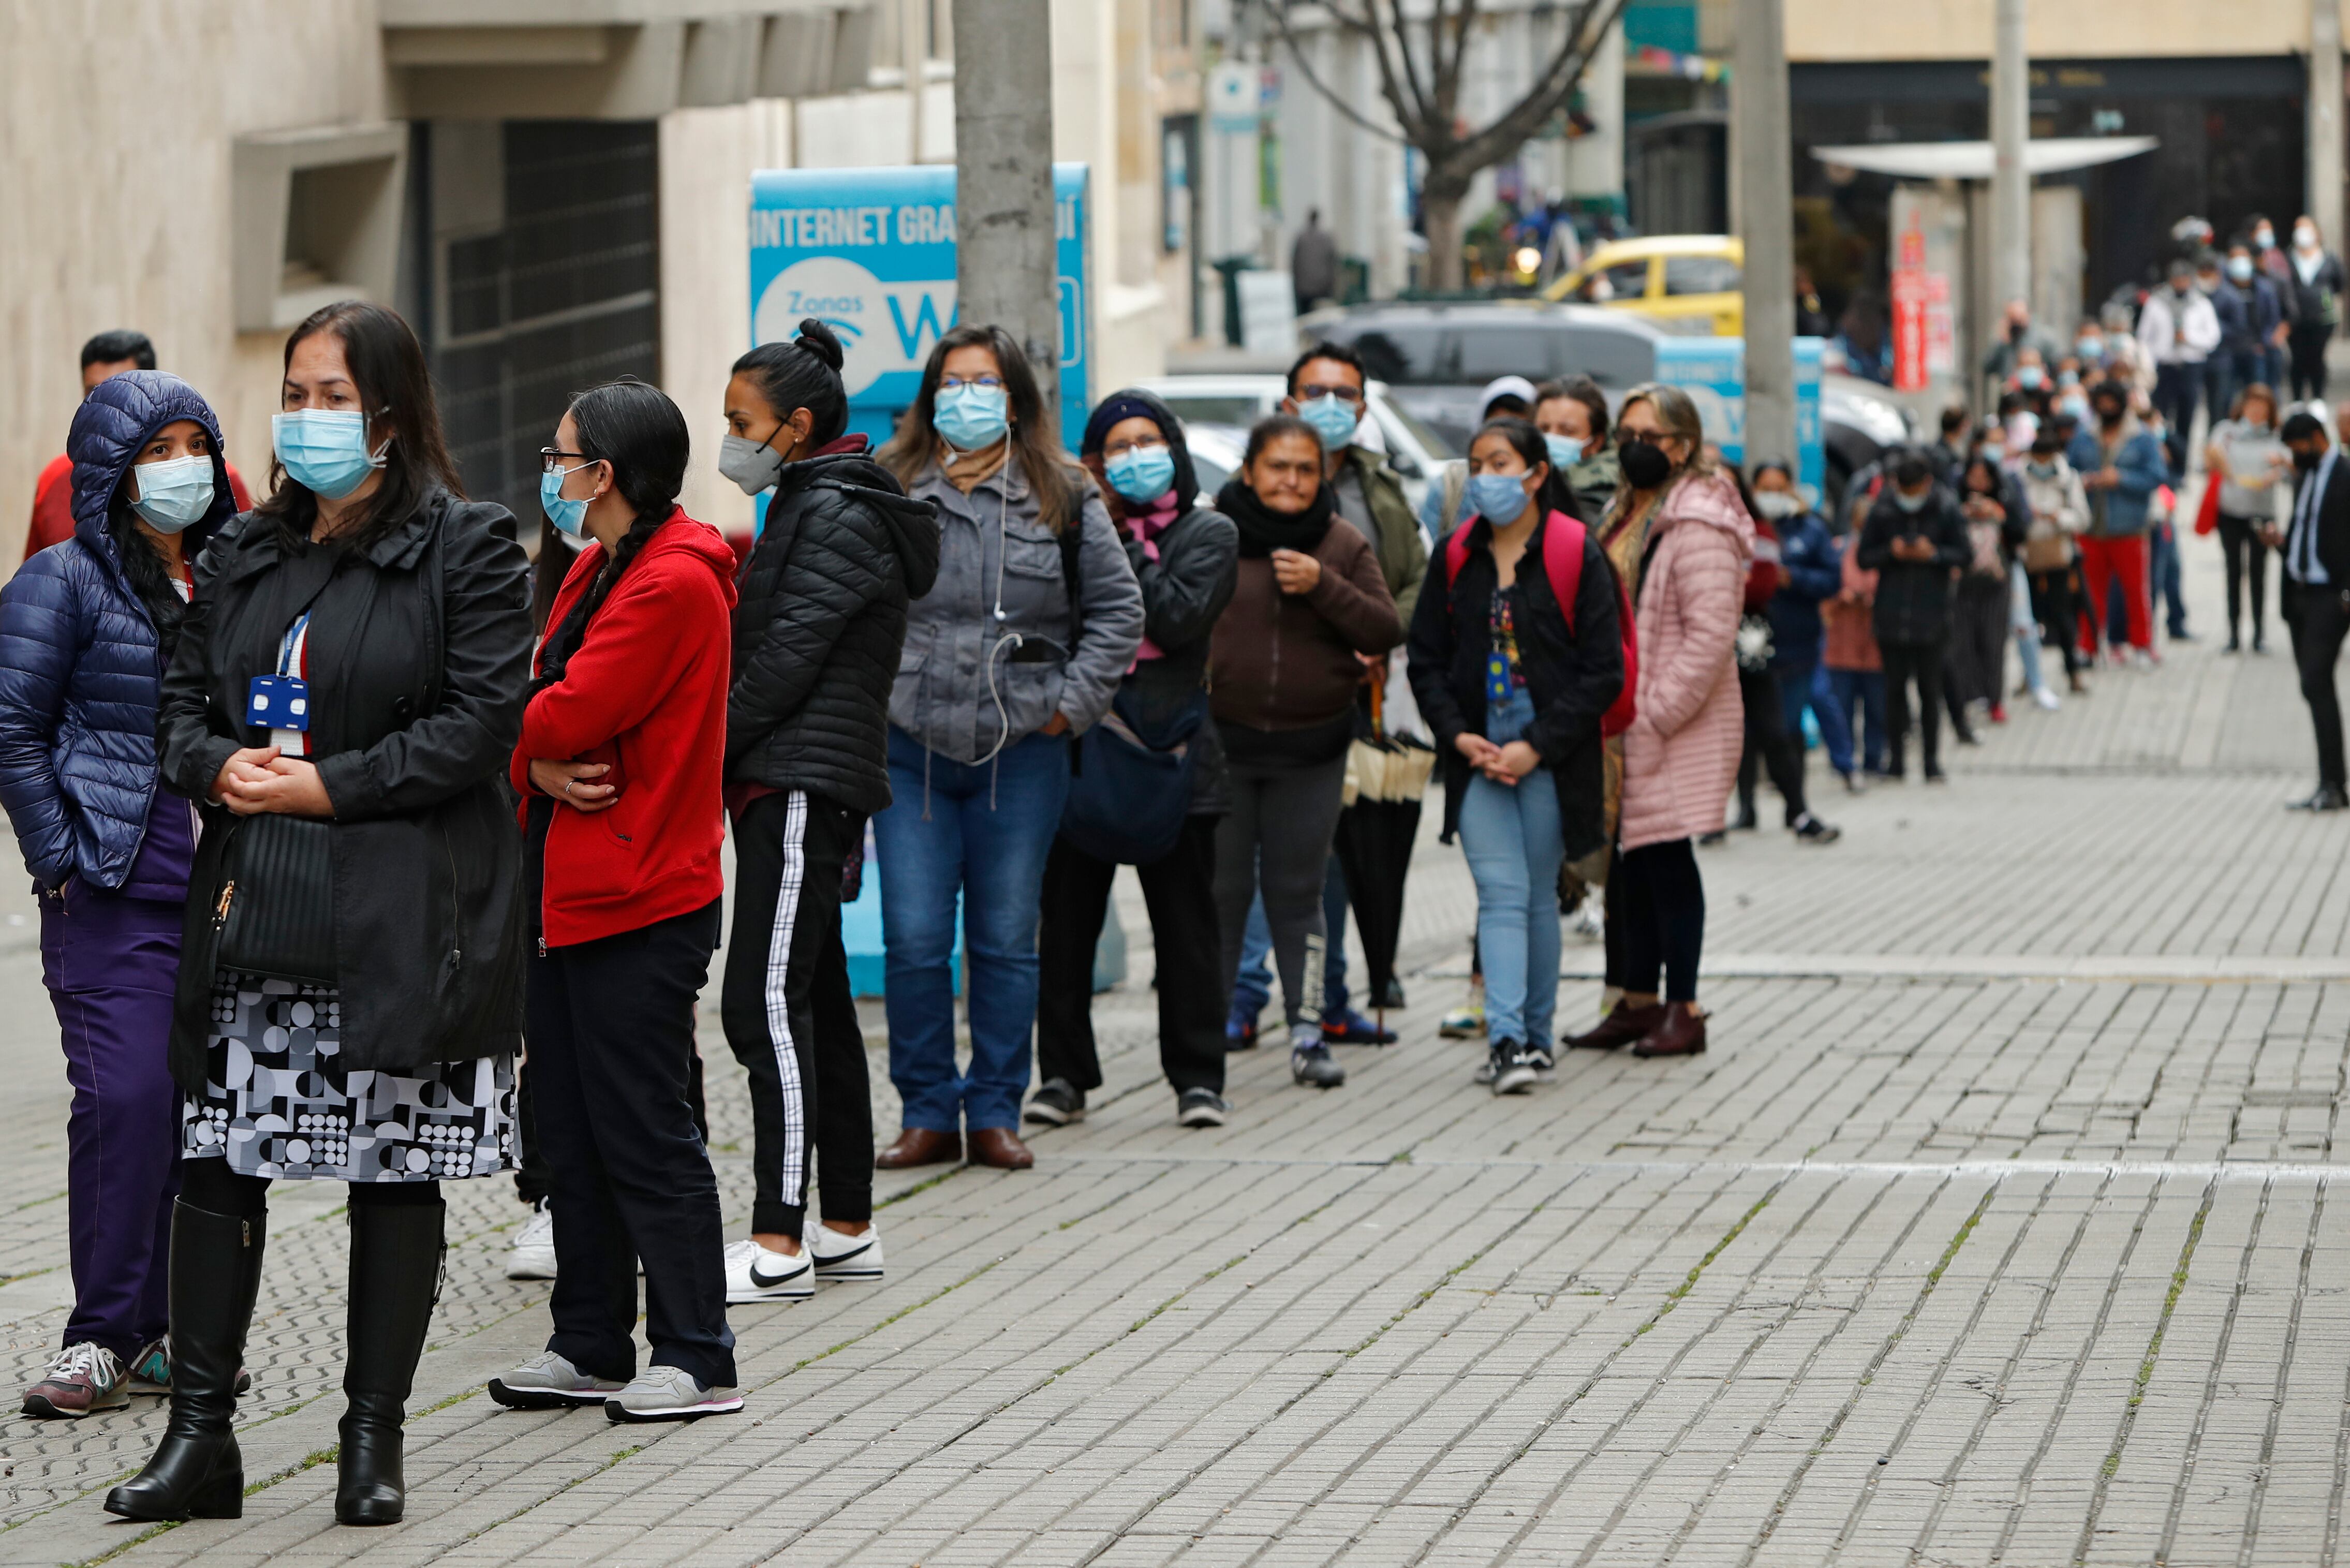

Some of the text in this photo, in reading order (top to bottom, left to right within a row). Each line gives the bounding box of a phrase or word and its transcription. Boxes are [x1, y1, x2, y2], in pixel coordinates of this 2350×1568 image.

[750, 206, 892, 248] INTERNET
[897, 204, 958, 245] GRA
[788, 290, 864, 313] Zonas
[886, 293, 959, 360] W
